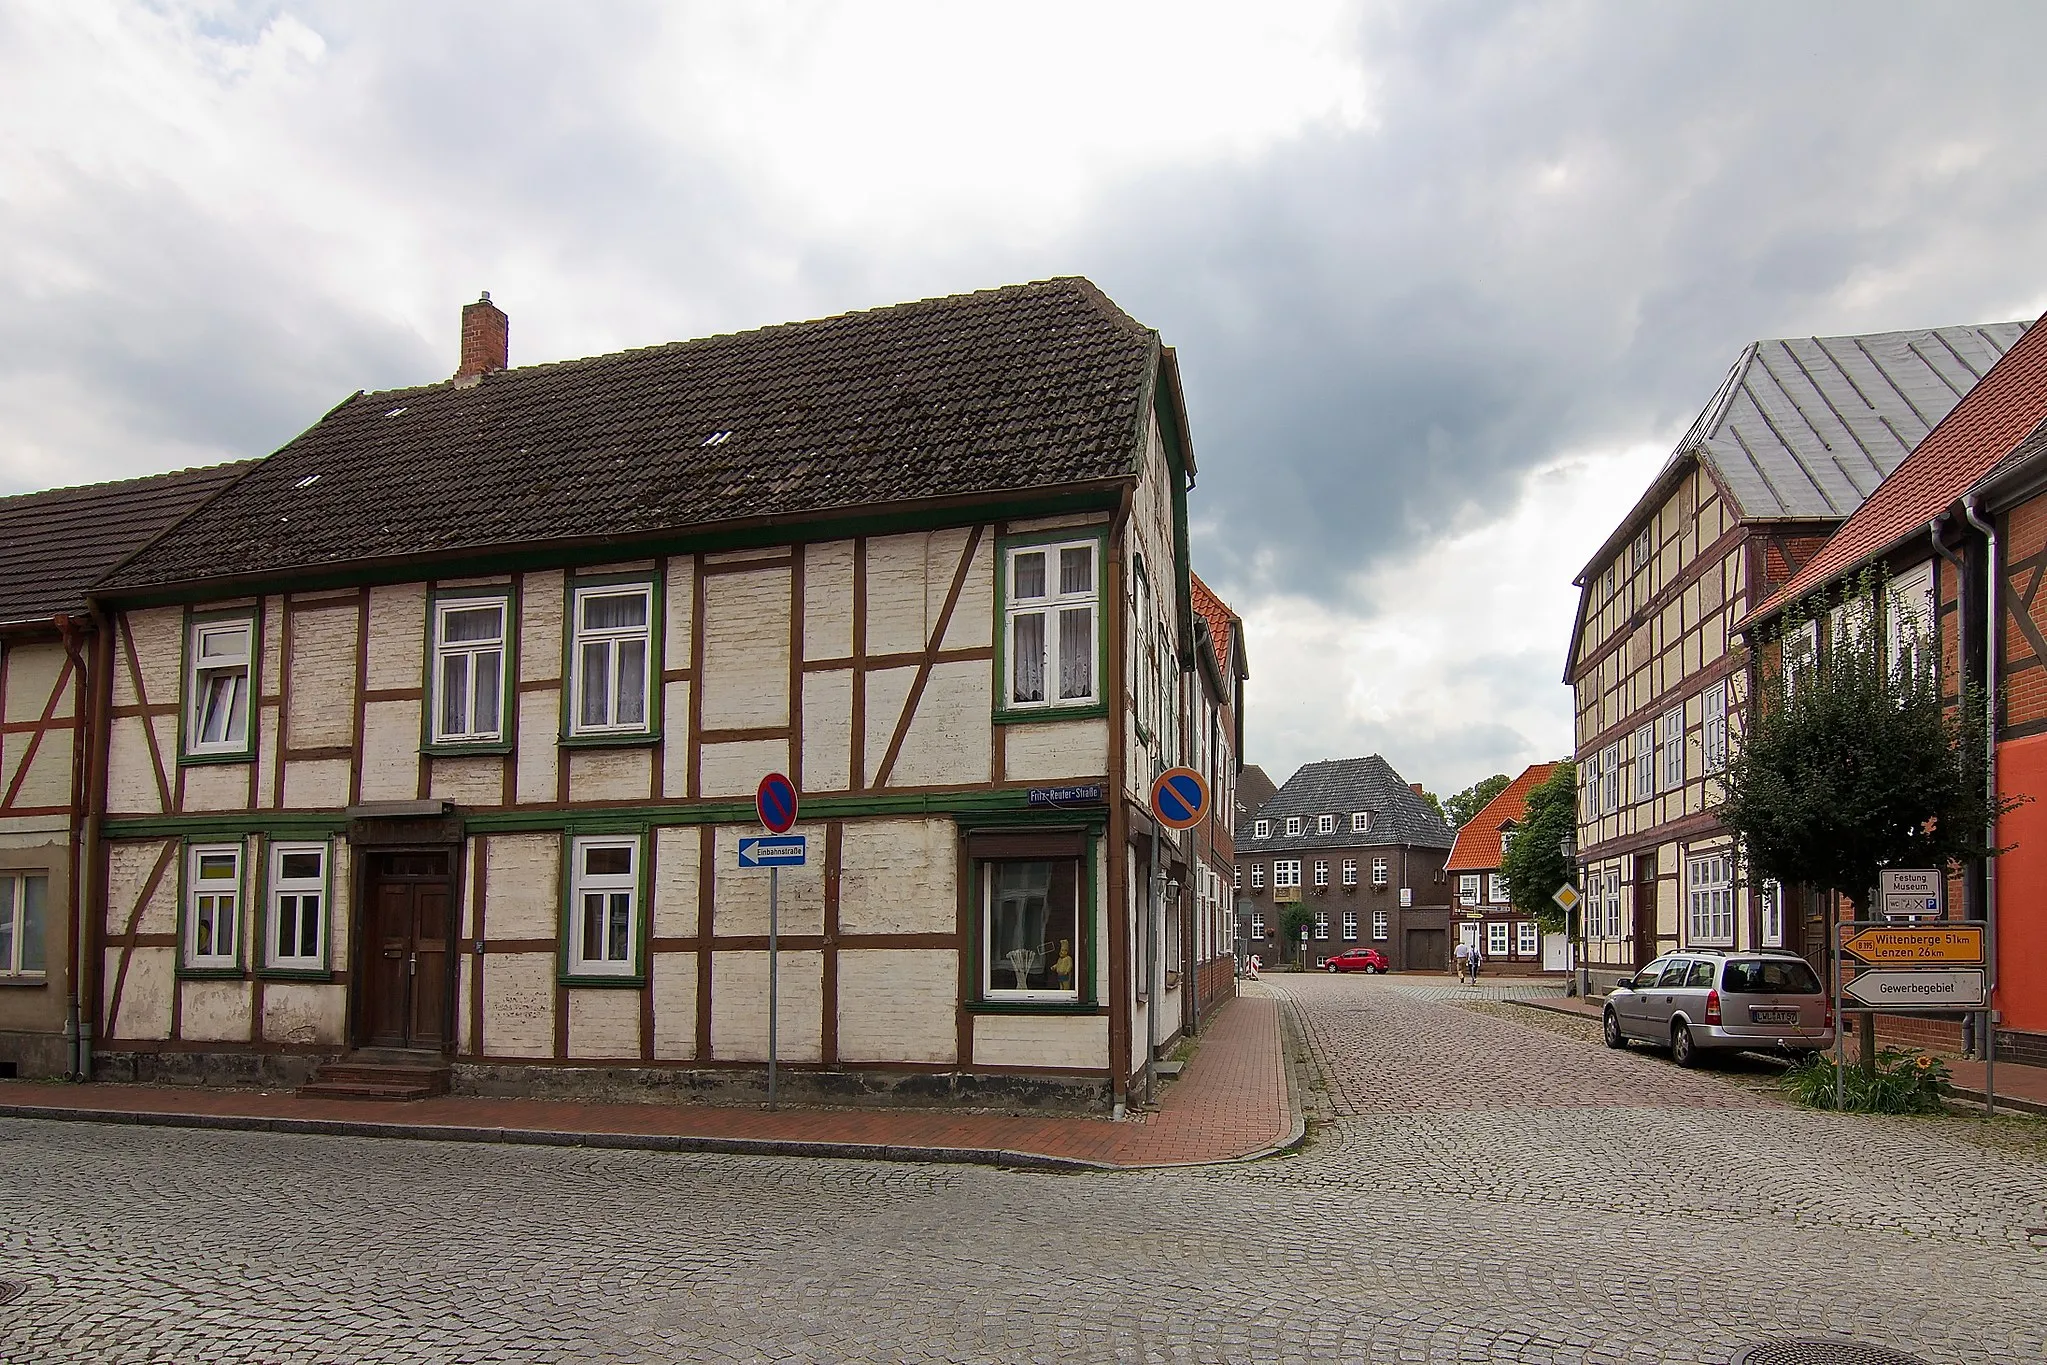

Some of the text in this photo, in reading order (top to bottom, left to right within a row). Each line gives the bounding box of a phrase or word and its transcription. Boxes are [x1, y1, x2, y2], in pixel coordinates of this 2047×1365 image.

[1030, 787, 1098, 801] Fritz-Reuter-Straße
[757, 847, 802, 855] Einbahnstraße
[1894, 874, 1927, 883] Festung
[1875, 934, 1941, 946] Wittenberge
[1875, 948, 1914, 957] Lenzen
[1880, 983, 1954, 994] Gewerbegebiet
